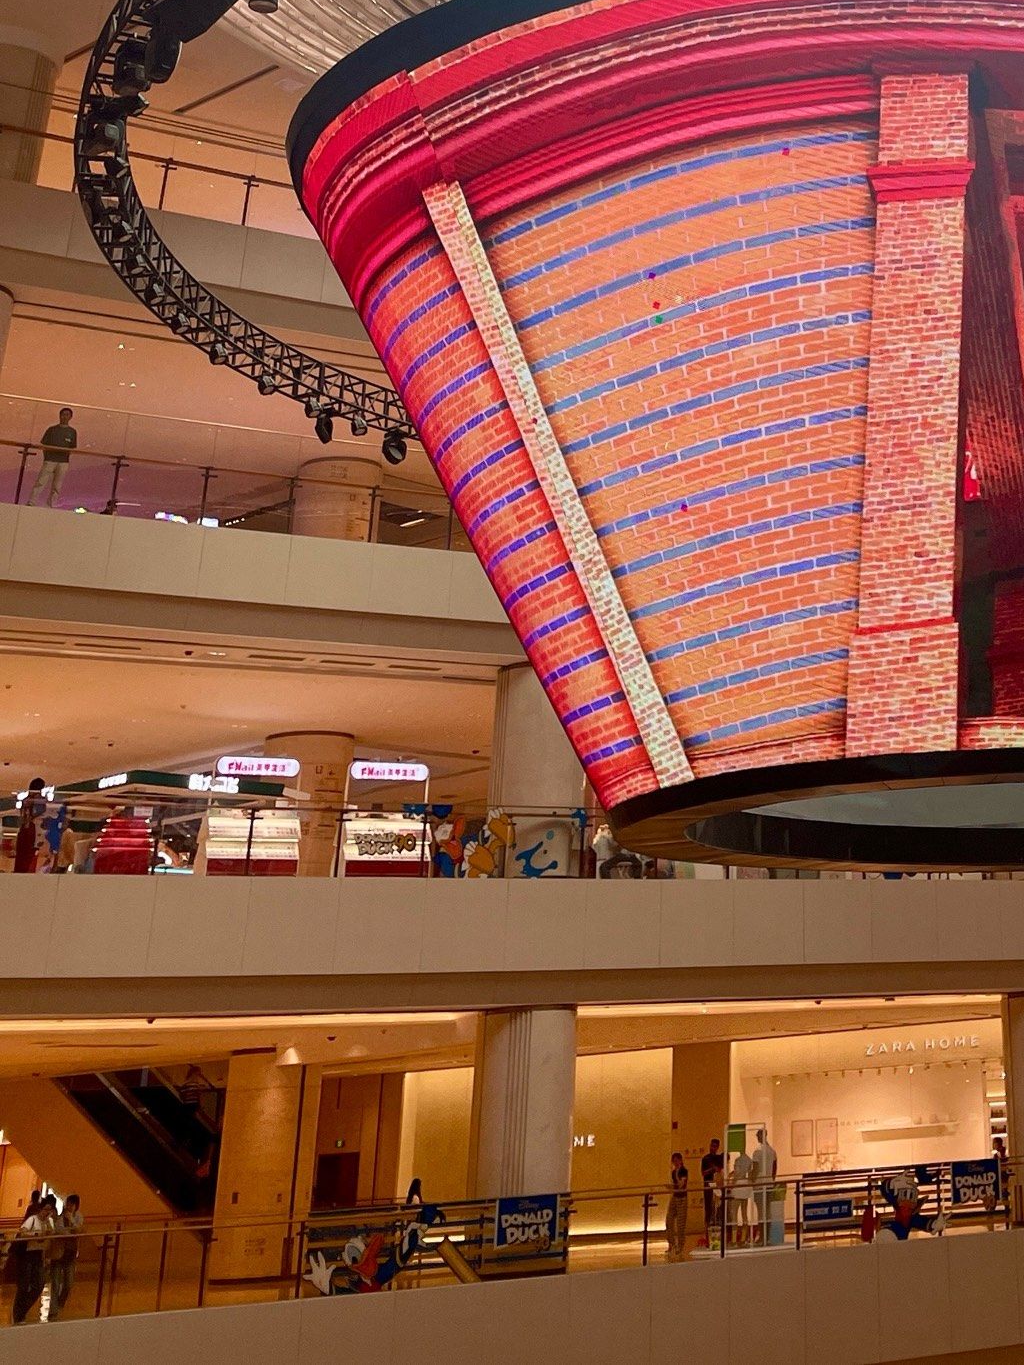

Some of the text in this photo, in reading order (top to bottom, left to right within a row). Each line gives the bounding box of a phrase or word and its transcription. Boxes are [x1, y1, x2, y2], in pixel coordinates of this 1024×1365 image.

[865, 1035, 980, 1057] ZARA HOME
[954, 1171, 997, 1189] DONALD
[959, 1184, 996, 1204] DUCK
[501, 1208, 553, 1229] DONALD
[505, 1222, 551, 1245] DUCK
